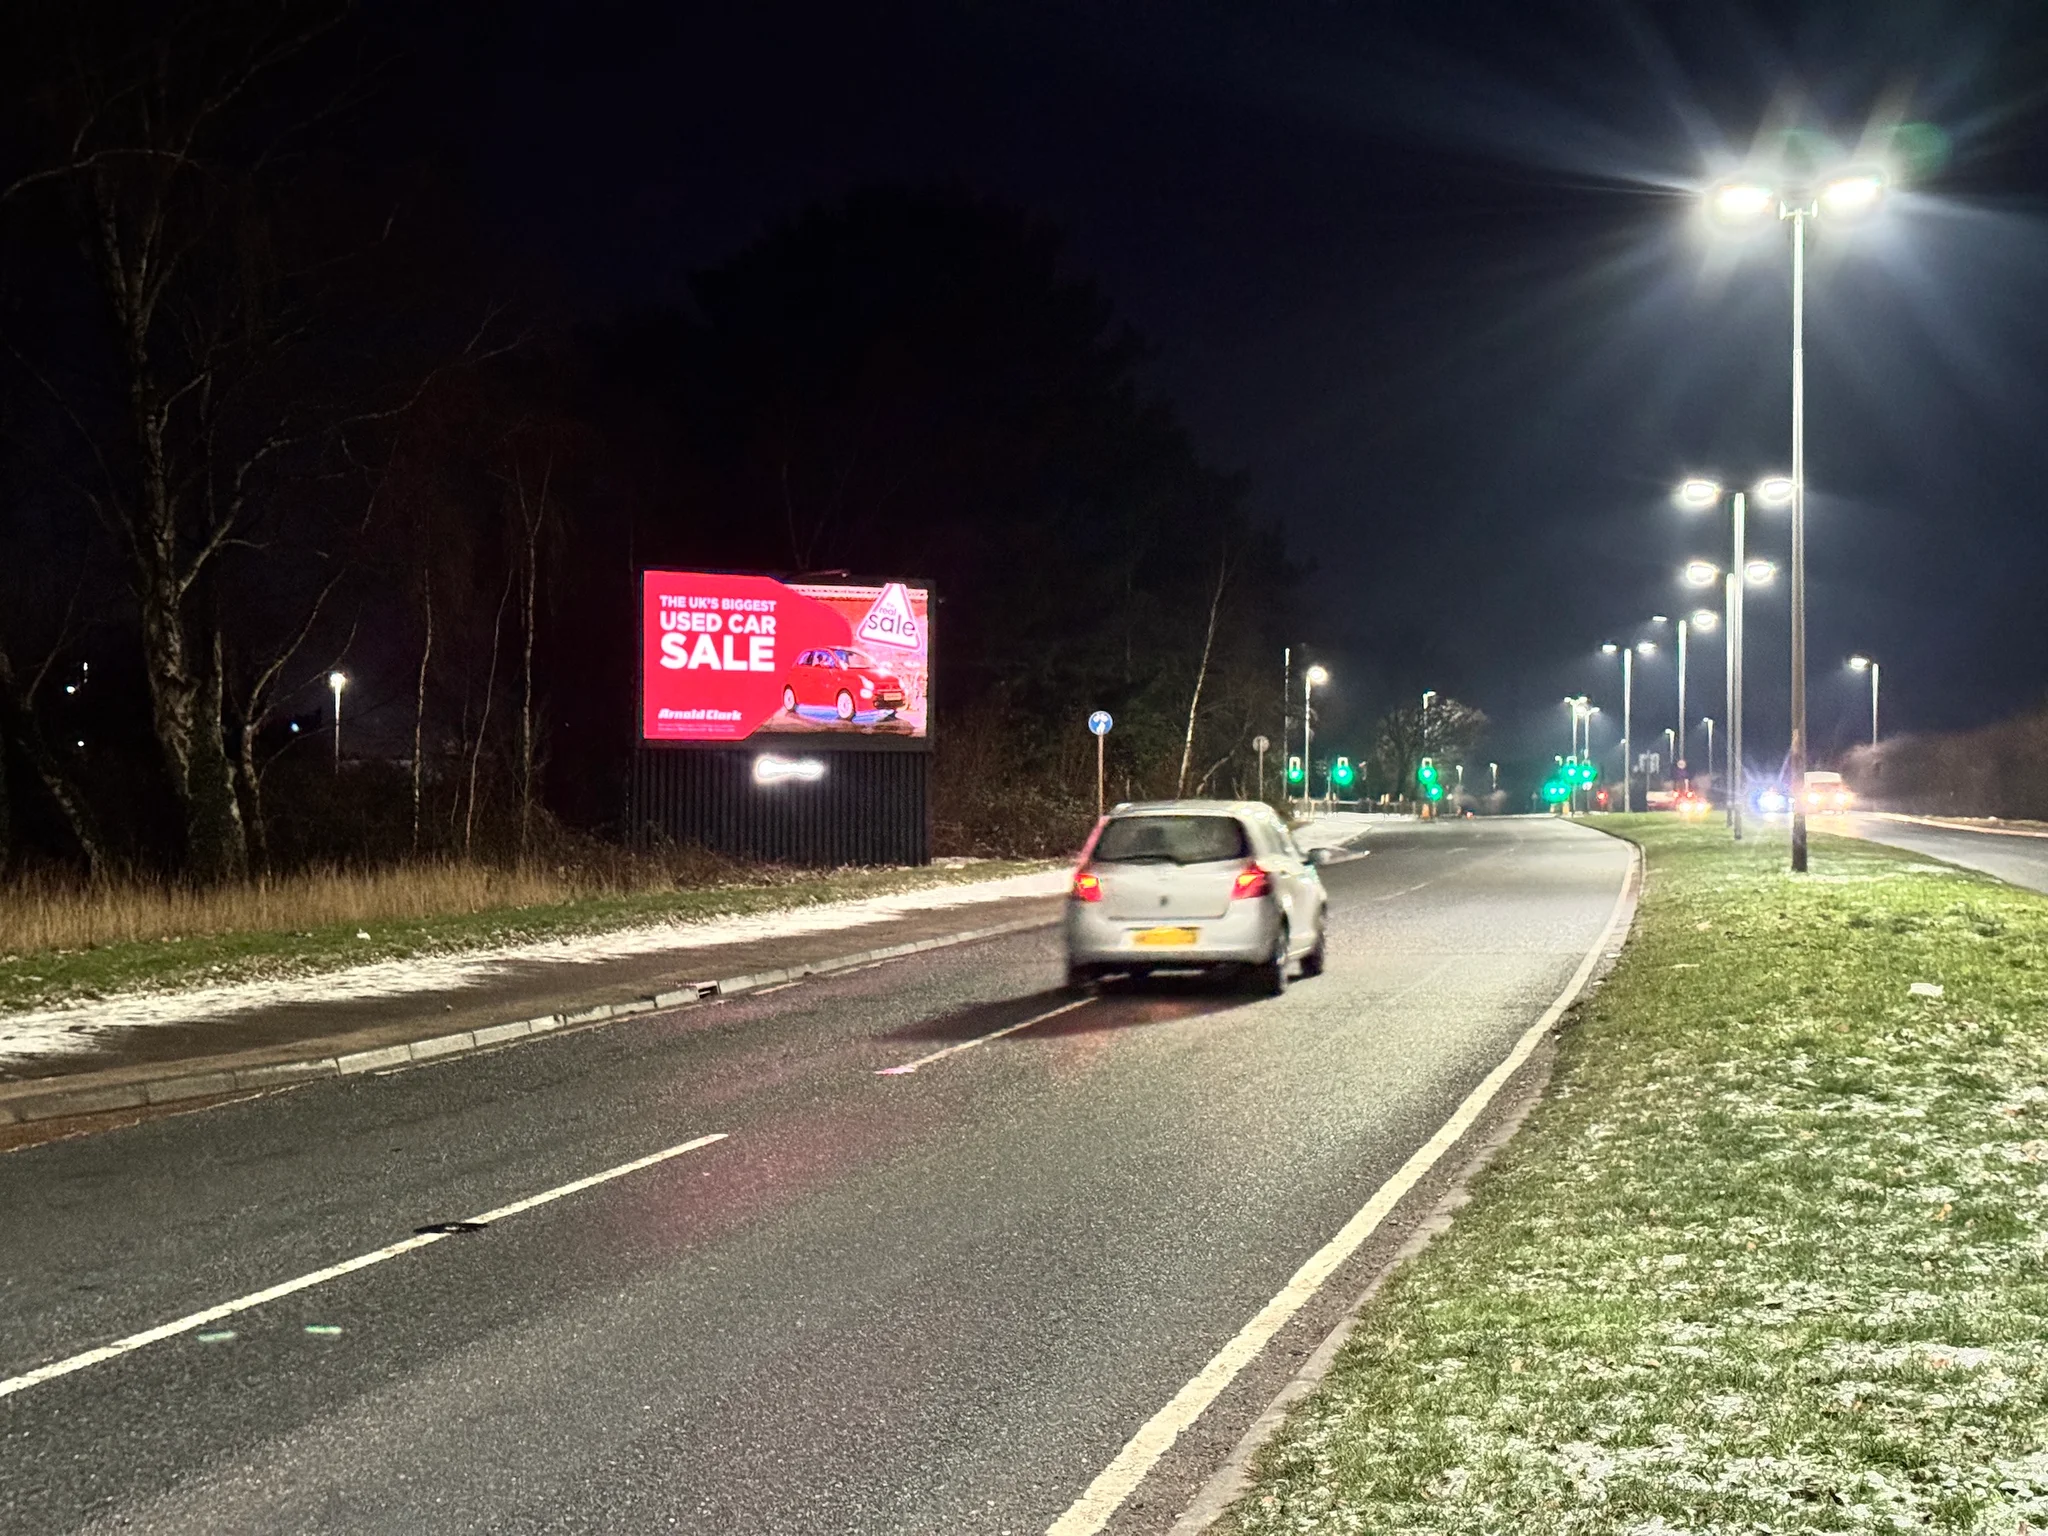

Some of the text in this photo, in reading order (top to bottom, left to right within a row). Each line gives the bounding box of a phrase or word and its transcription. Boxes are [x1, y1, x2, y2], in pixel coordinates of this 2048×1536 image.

[659, 595, 777, 612] THE UK'S BIGGEST
[660, 610, 776, 635] USED CAR
[868, 614, 915, 636] sale
[659, 632, 775, 672] SALE
[658, 708, 742, 721] Arnold Clark
